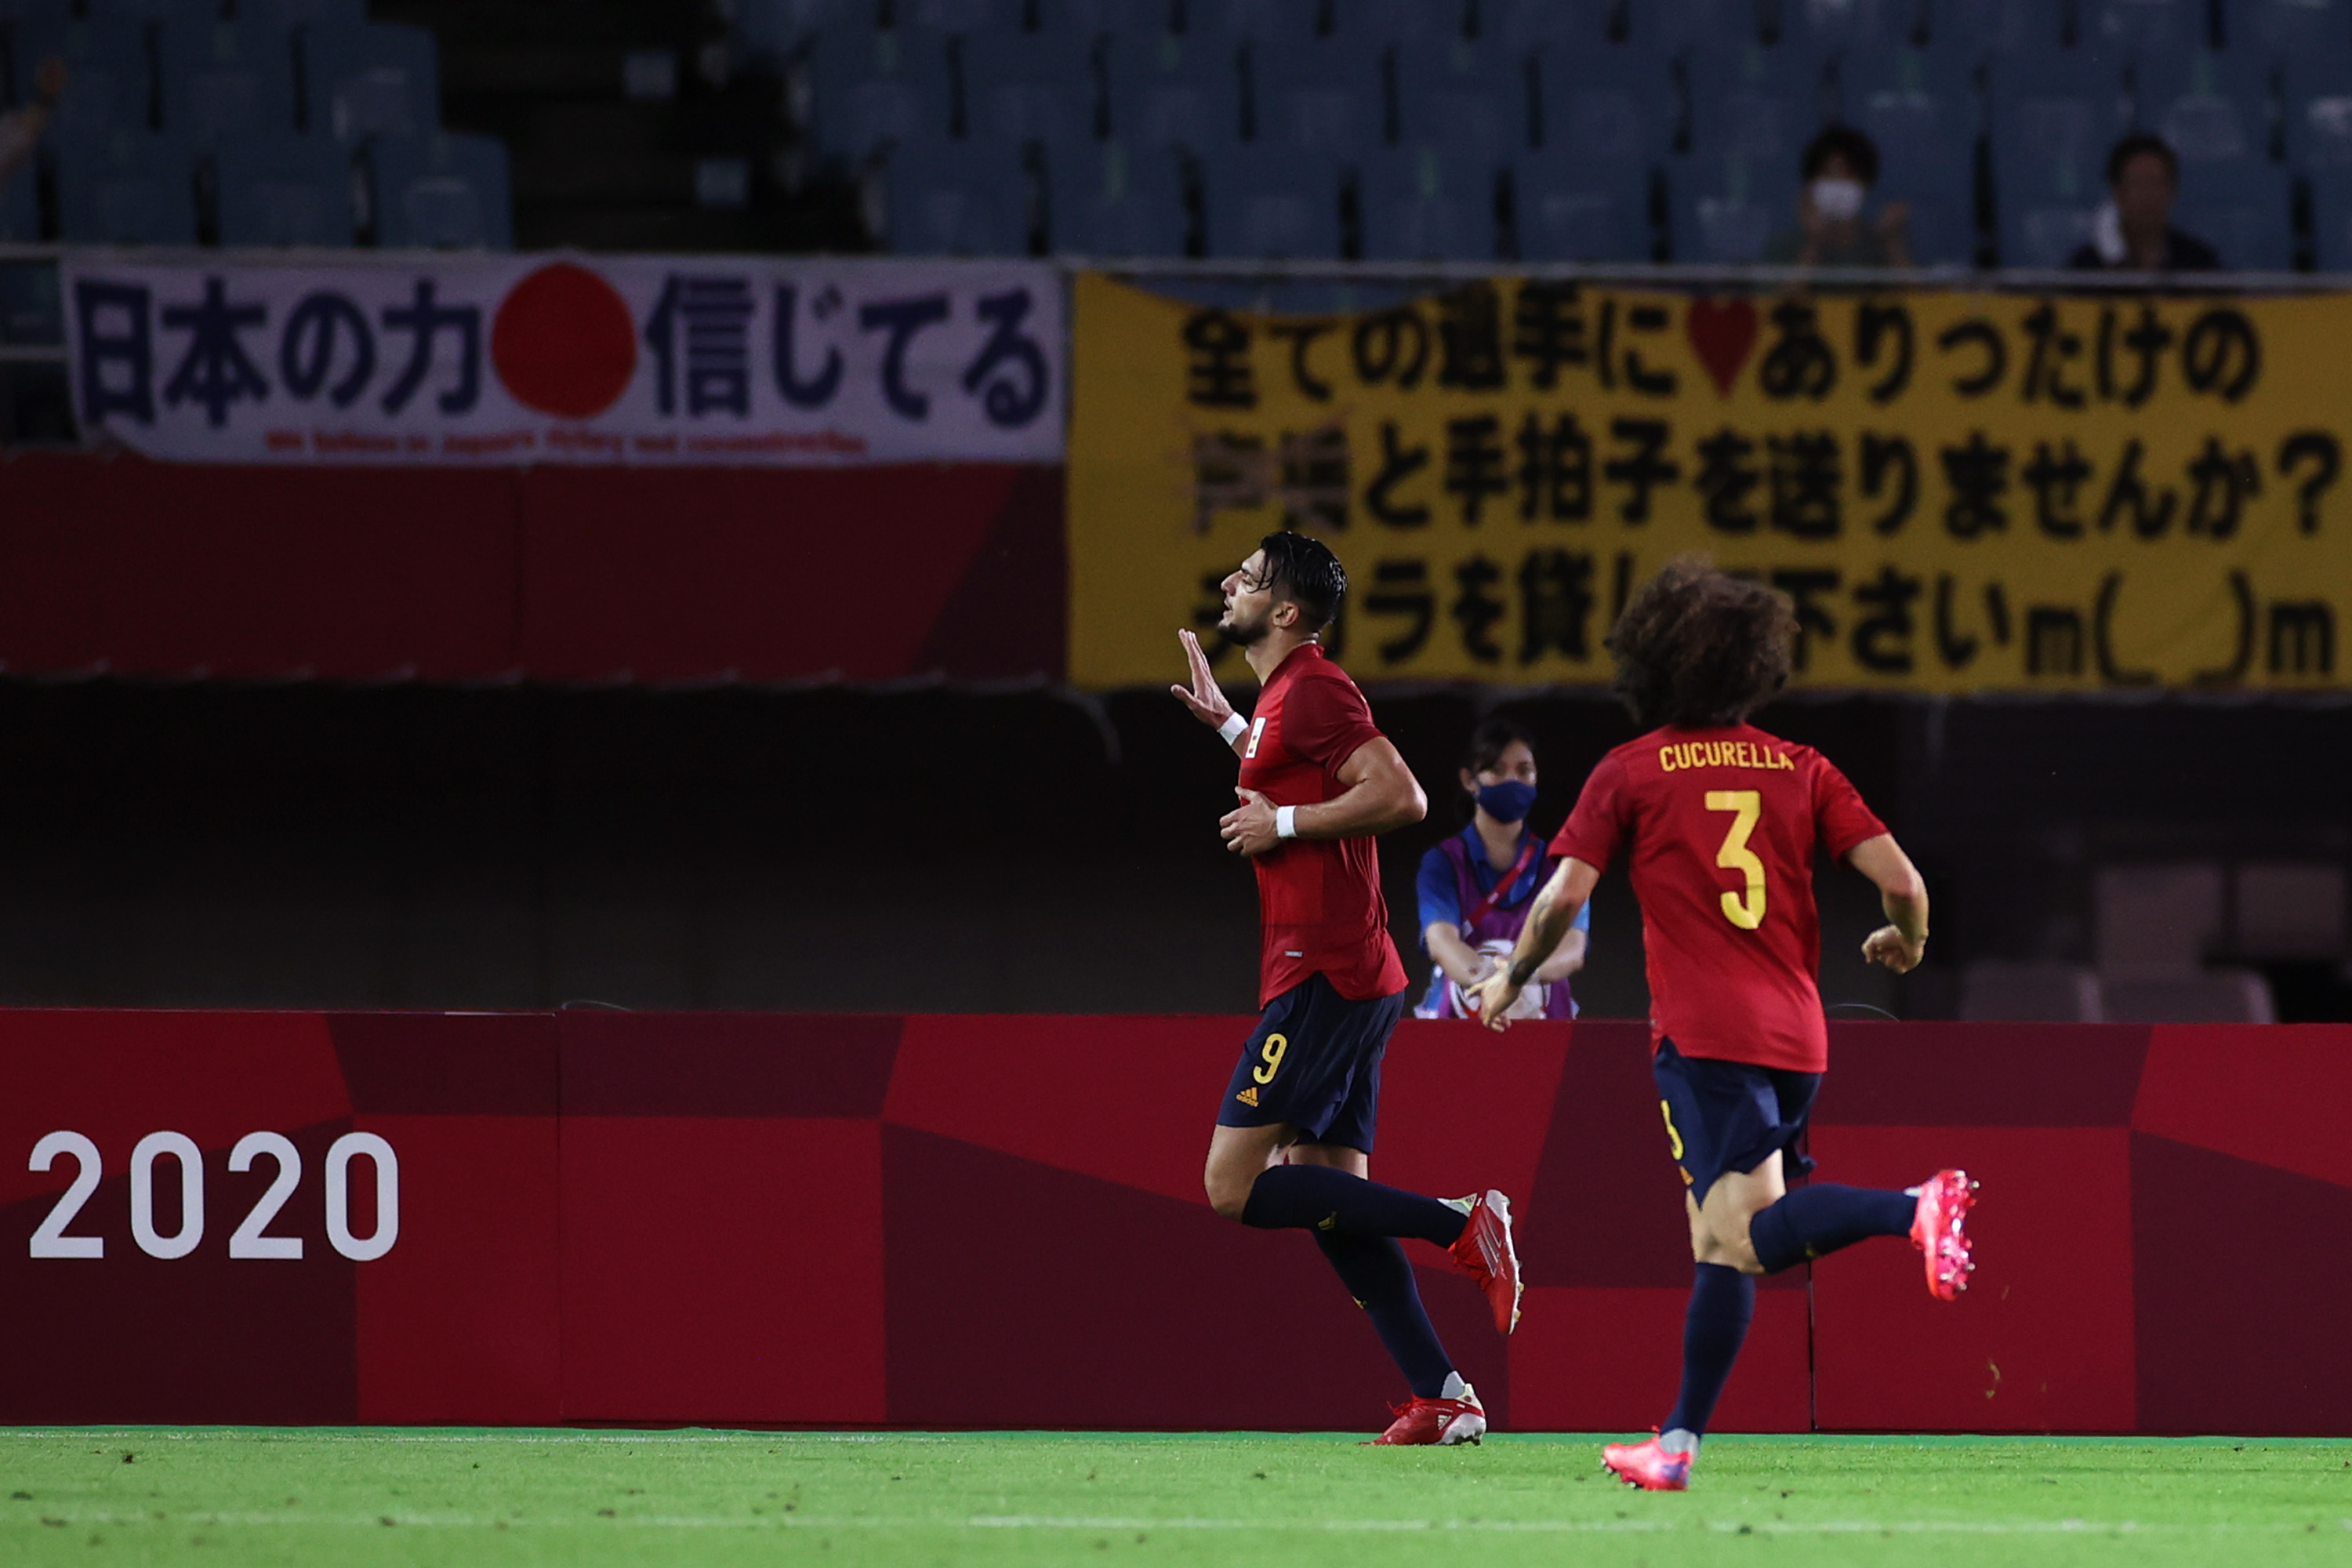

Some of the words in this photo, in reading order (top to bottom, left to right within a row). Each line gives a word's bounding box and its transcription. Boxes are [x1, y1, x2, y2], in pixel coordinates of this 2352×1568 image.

[74, 274, 481, 427] 日本の力
[645, 272, 1051, 429] 信じてる
[1760, 300, 2261, 408] ありったけの
[1659, 740, 1795, 772] CUCURELLA
[1704, 789, 1768, 931] 3
[1252, 1033, 1288, 1085] 9
[28, 1130, 400, 1262] 2020
